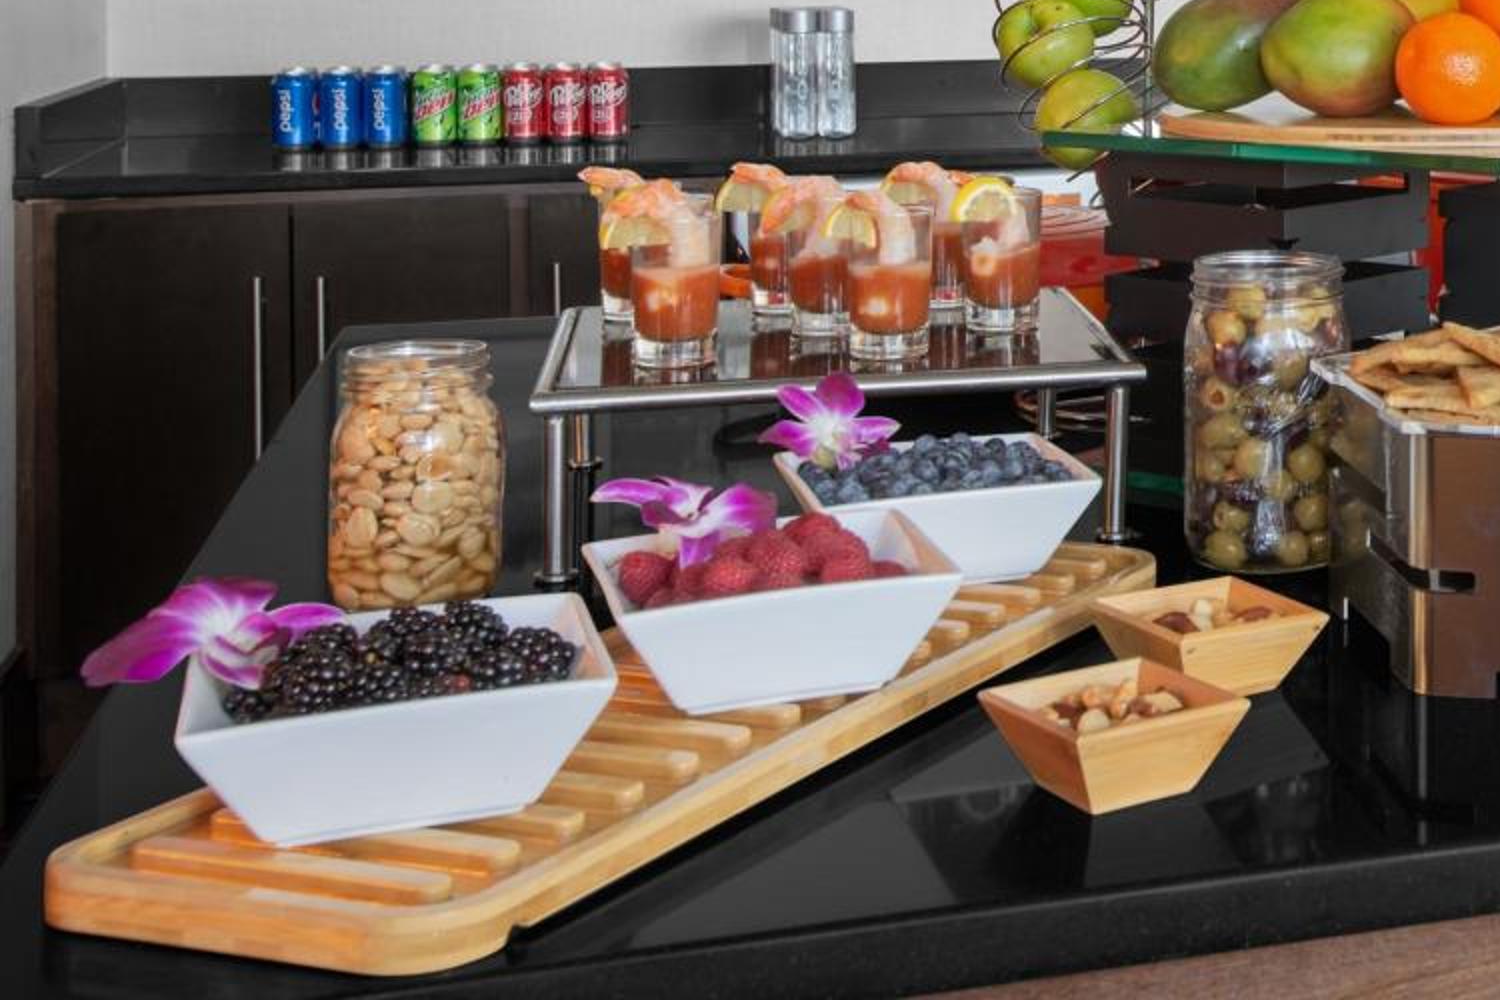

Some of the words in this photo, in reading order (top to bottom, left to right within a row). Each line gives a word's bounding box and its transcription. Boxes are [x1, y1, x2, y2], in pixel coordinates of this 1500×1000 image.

[278, 89, 293, 132] pepsi
[332, 88, 348, 131] pepsi
[372, 88, 388, 131] pepsi
